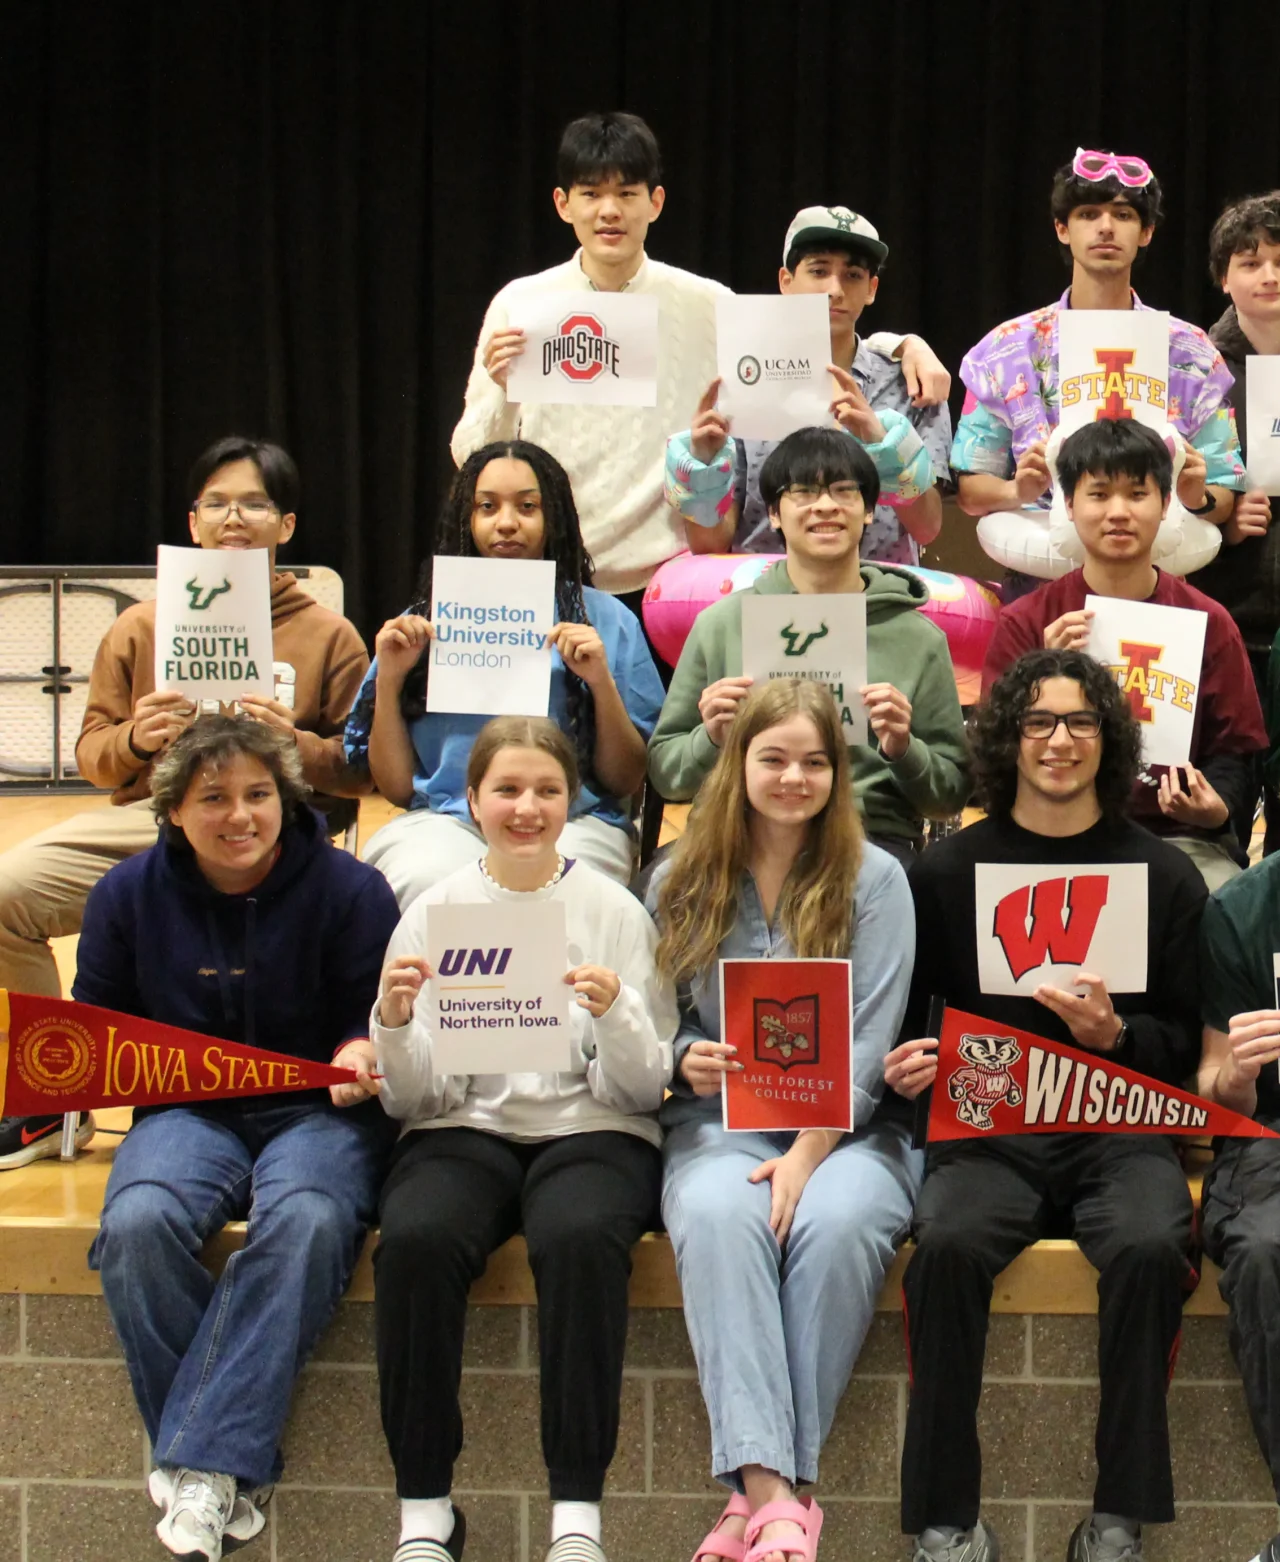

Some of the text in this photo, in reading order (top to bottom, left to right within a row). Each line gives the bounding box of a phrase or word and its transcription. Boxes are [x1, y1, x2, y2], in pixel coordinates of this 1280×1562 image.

[543, 331, 620, 379] OHIO STATE
[764, 358, 811, 370] UCAM
[1061, 371, 1166, 409] STATE
[437, 601, 536, 625] Kingston
[175, 624, 246, 633] UNIVERSITY of
[436, 625, 548, 650] University
[172, 636, 249, 657] SOUTH
[435, 648, 511, 669] London
[165, 660, 260, 681] FLORIDA
[833, 671, 842, 679] of
[1104, 664, 1196, 714] TATE
[992, 875, 1110, 983] W
[438, 948, 513, 976] UNI
[439, 997, 542, 1013] University of
[439, 1015, 515, 1029] Northern
[786, 1011, 813, 1024] 1857
[102, 1026, 191, 1097] IOWA
[743, 1074, 835, 1092] LAKE FOREST
[1023, 1046, 1209, 1128] WISCONSIN
[755, 1088, 818, 1104] COLLEGE
